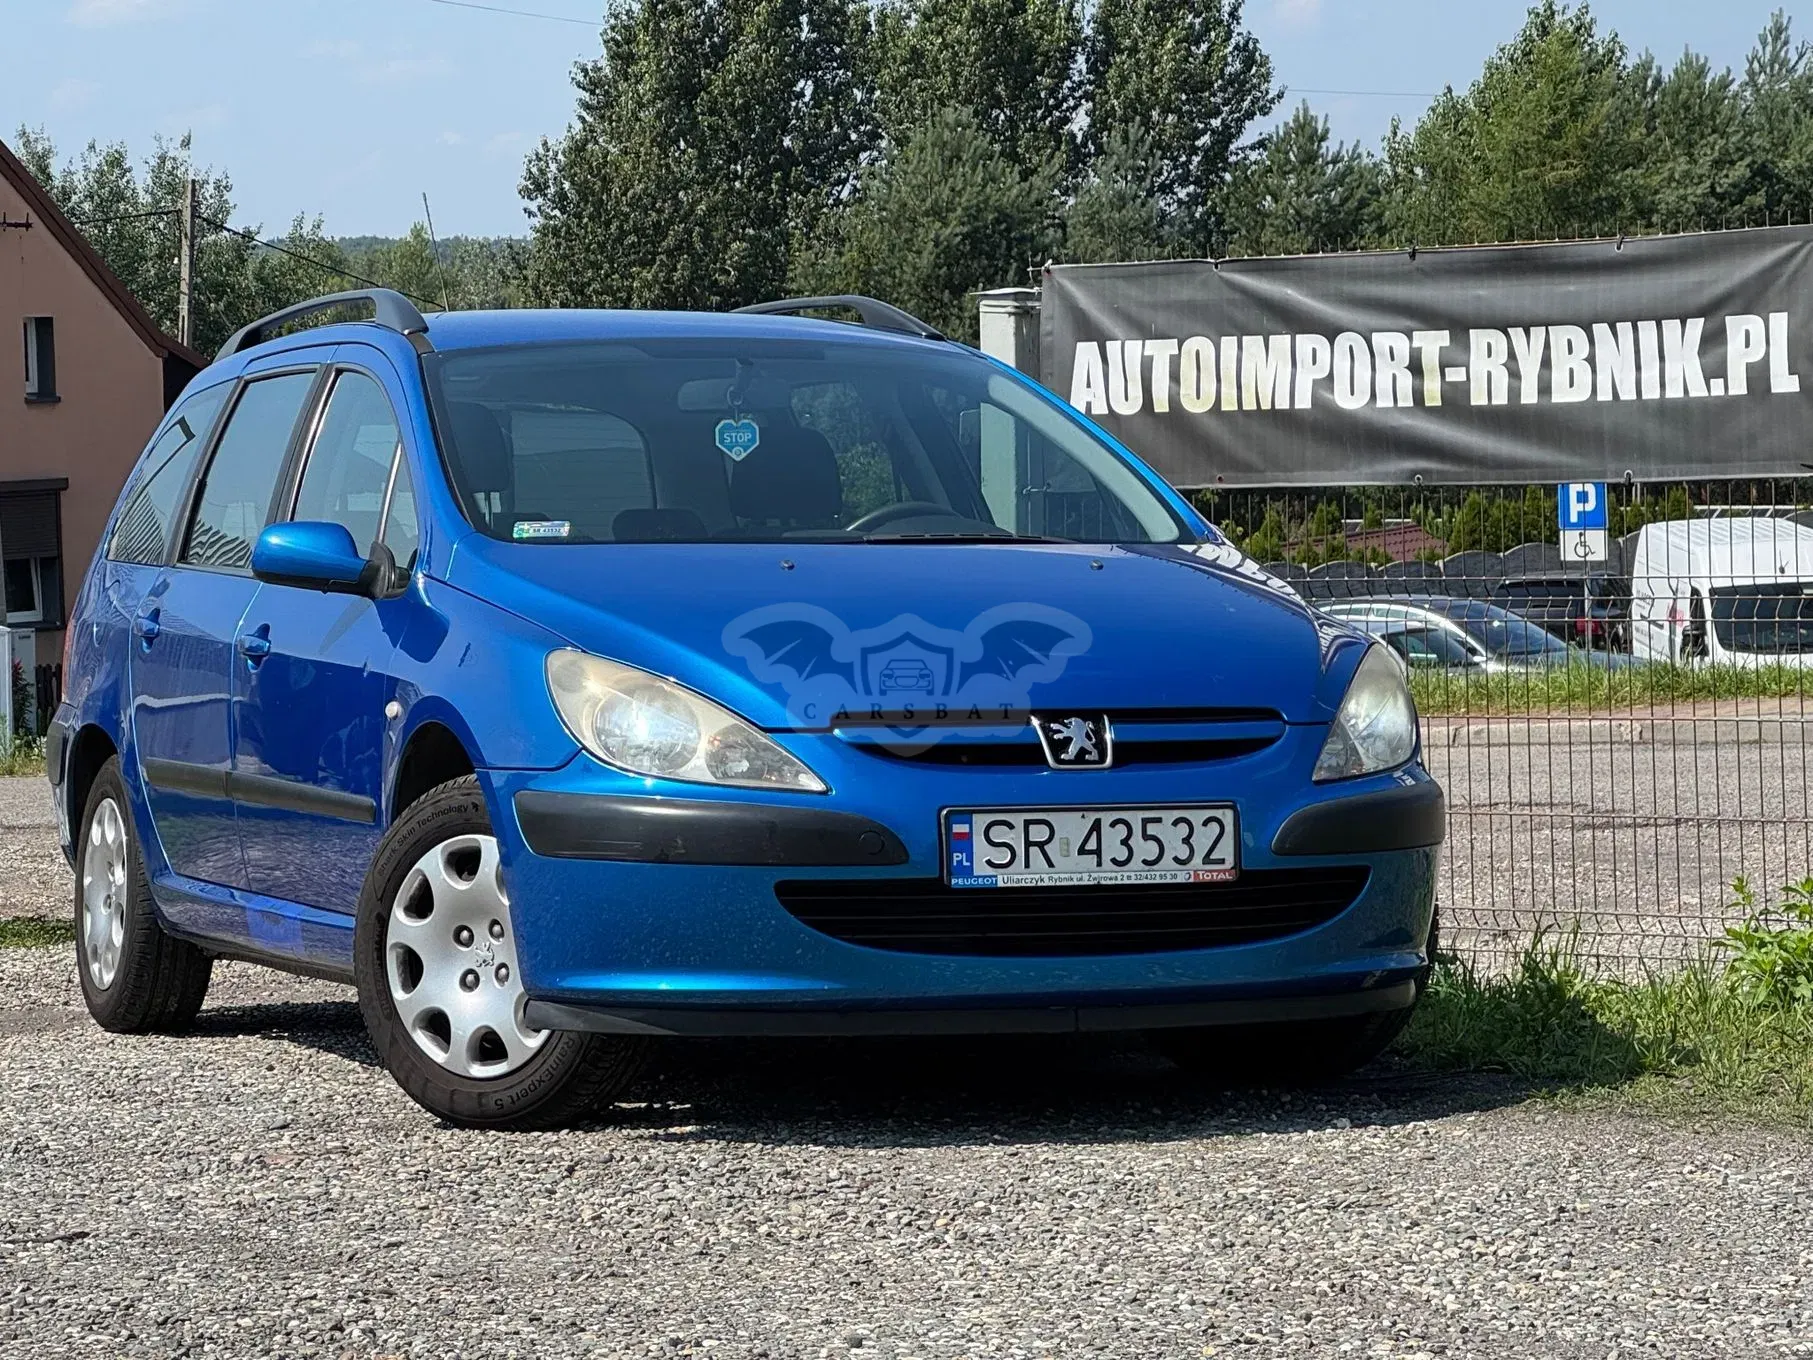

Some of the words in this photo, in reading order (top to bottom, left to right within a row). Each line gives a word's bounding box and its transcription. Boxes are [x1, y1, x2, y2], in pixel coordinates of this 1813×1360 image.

[1070, 312, 1800, 415] AUTOIMPORT-RYBNIK.PL
[723, 432, 752, 443] STOP
[1569, 483, 1596, 523] P
[397, 826, 416, 846] Skin
[417, 804, 469, 828] Technology
[982, 818, 1056, 869] SR
[1077, 815, 1226, 868] 43532
[952, 853, 971, 866] PL
[951, 877, 997, 886] PEUGEOT
[1002, 875, 1046, 886] Uliarczyk
[1048, 875, 1075, 885] Rybnik
[1134, 873, 1157, 881] 32/432
